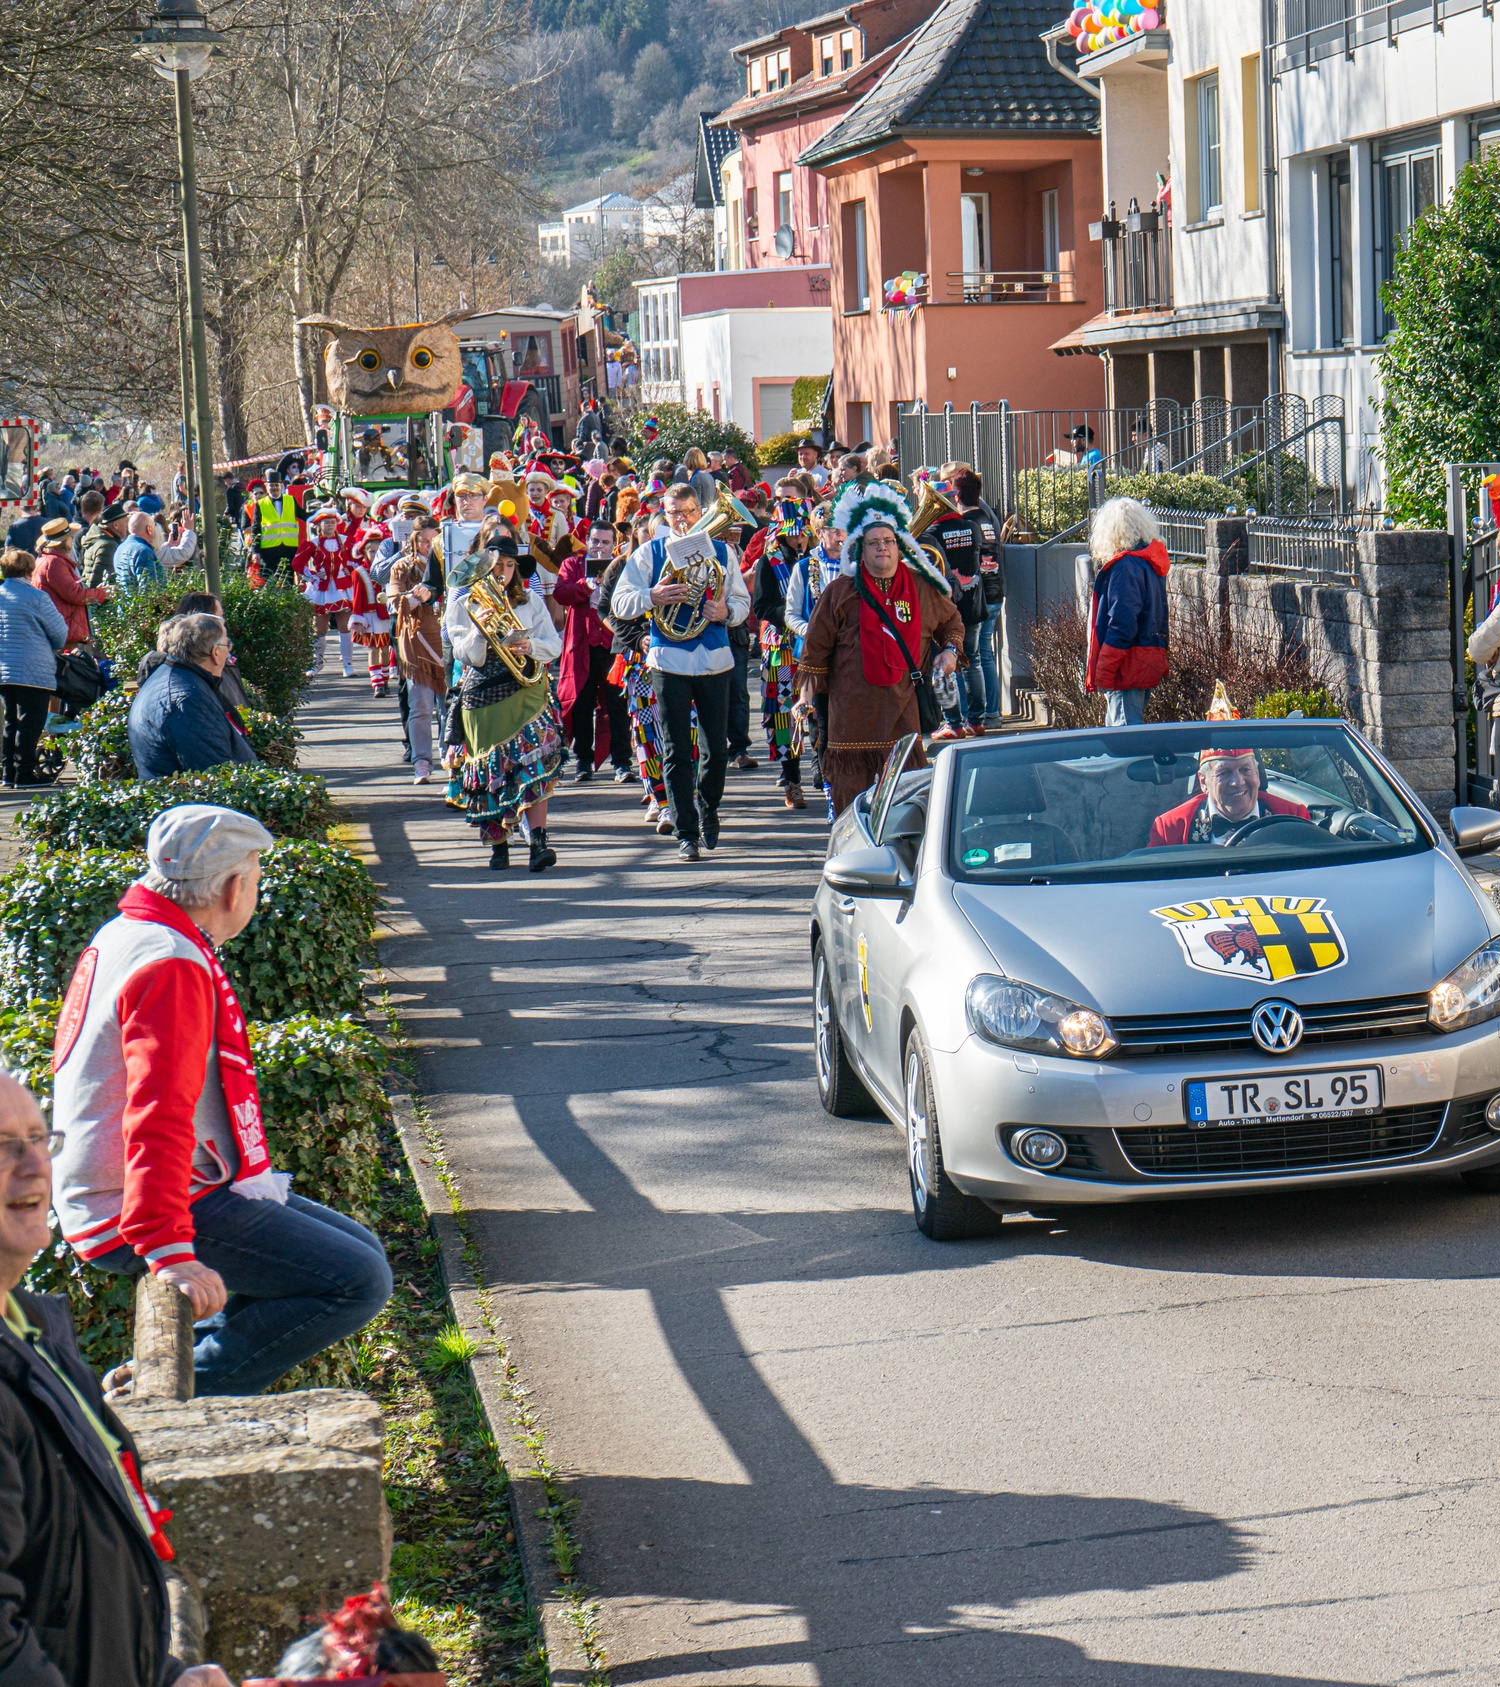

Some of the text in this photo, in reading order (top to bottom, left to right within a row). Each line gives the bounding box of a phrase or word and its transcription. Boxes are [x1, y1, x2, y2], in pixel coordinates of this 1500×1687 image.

[894, 600, 910, 608] UHU
[971, 849, 980, 858] 4
[1156, 896, 1320, 922] UHU
[1220, 1074, 1368, 1115] TR SL 95
[1194, 1106, 1202, 1116] D
[1218, 1119, 1236, 1127] Auto
[1241, 1117, 1261, 1125] Theis
[1265, 1113, 1305, 1123] Mettendorf
[1318, 1109, 1354, 1119] 06522/387
